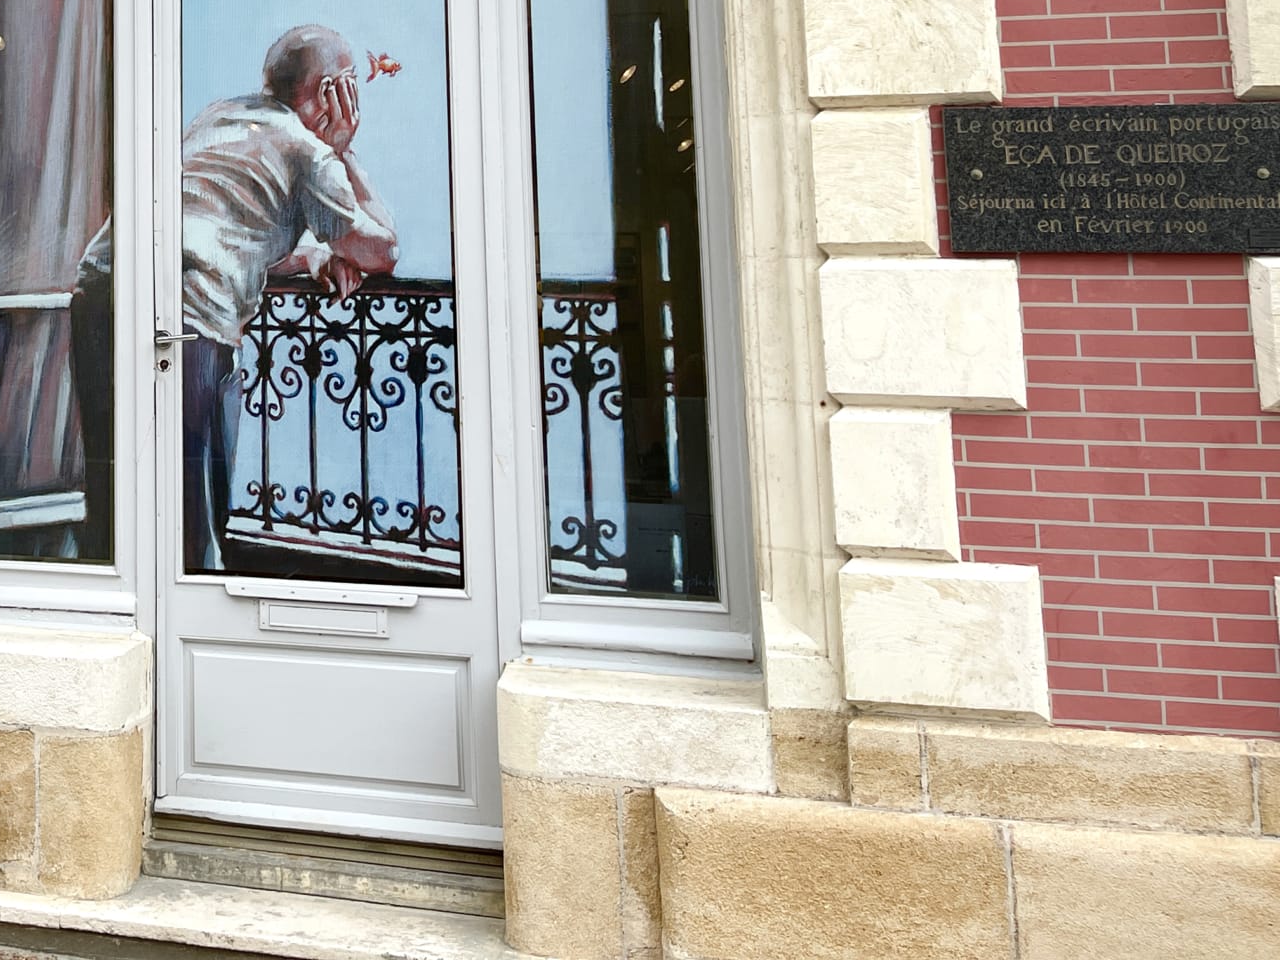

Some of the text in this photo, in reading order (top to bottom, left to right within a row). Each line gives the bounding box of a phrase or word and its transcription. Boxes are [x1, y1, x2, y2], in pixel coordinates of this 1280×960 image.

[956, 111, 1280, 148] Le grand écrivain portugais
[1004, 143, 1231, 167] EÇA DE QUEIROZ
[957, 193, 1035, 215] Séjourna
[1042, 193, 1066, 209] ici
[1081, 193, 1091, 209] à
[1037, 214, 1208, 234] en Février 1900
